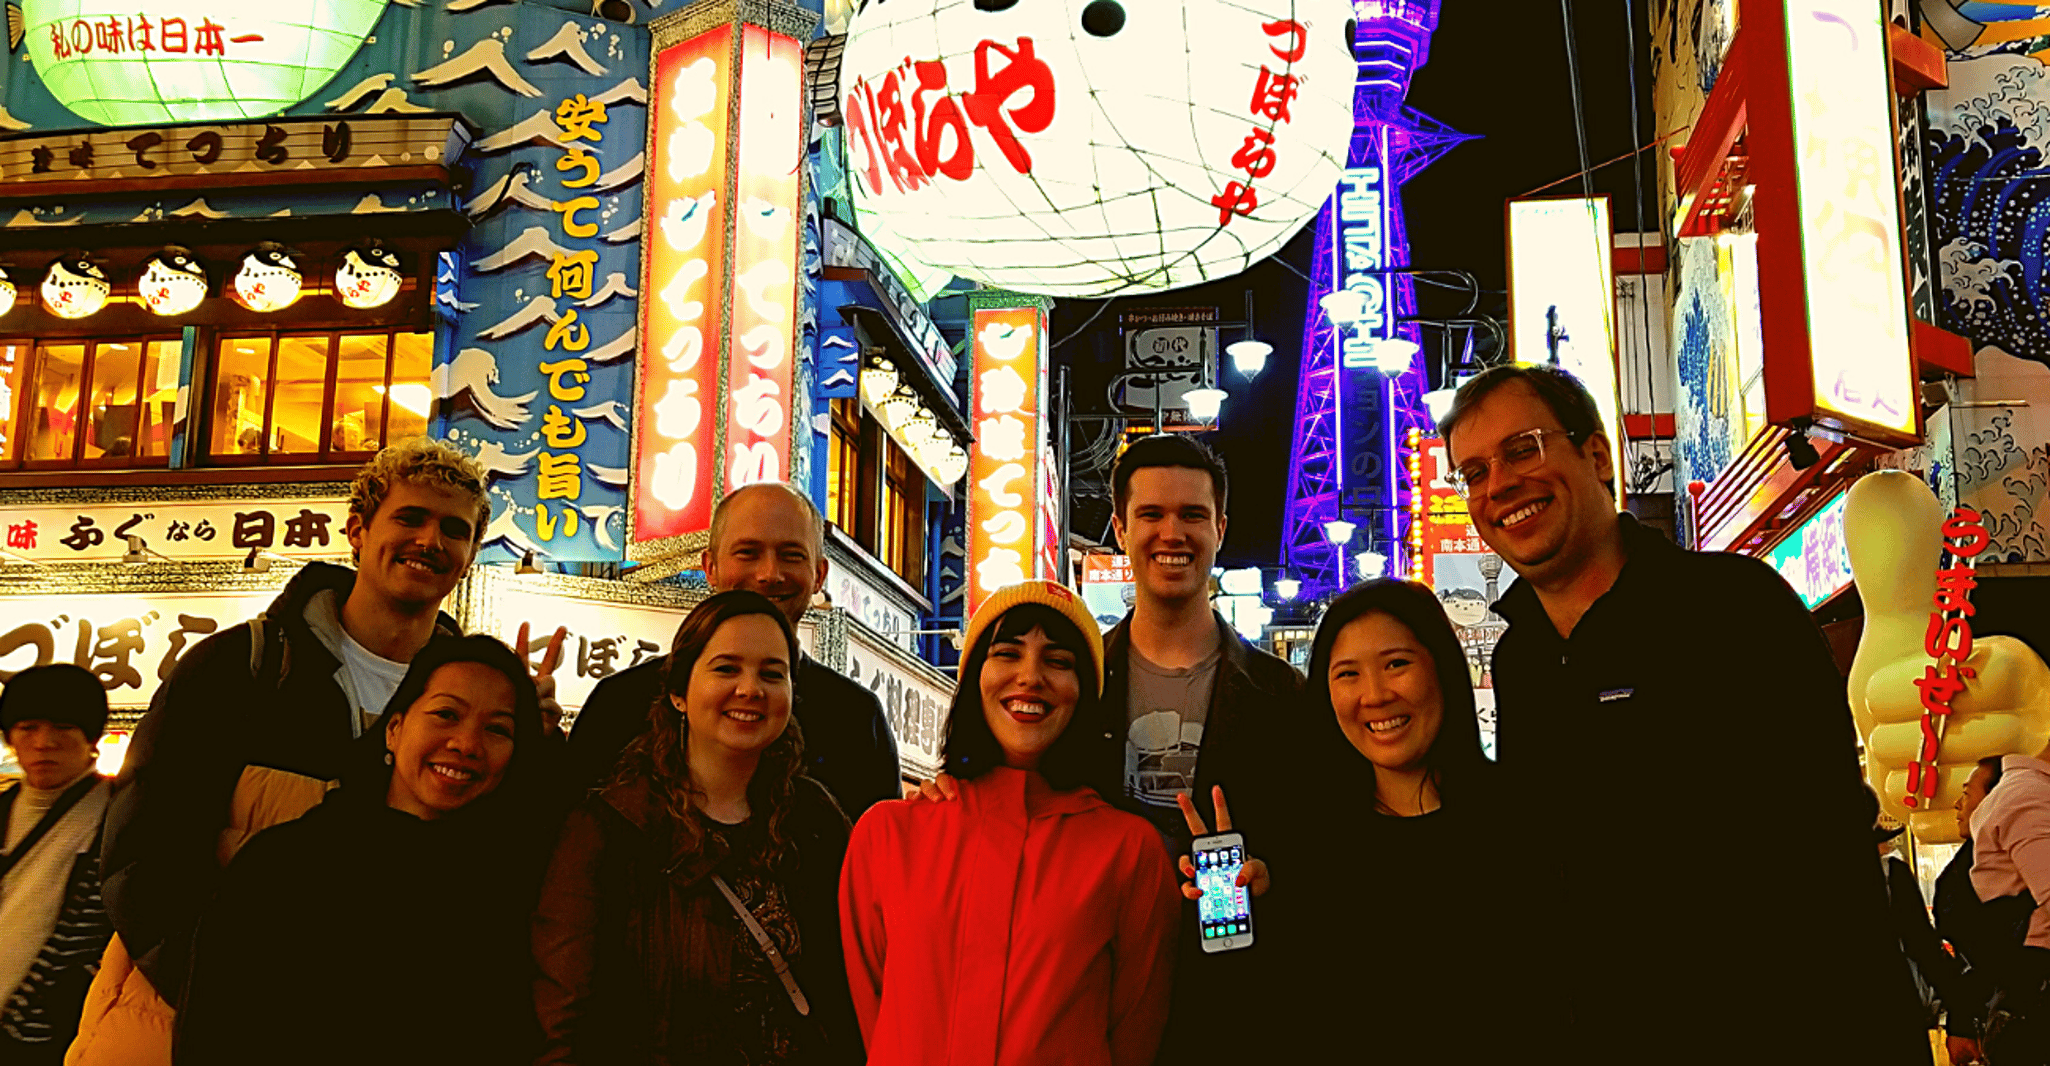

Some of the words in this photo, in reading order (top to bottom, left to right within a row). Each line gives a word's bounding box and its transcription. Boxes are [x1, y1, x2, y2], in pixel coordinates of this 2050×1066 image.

[50, 12, 264, 60] 私の味は日本一
[535, 94, 608, 541] 安うて何んでも旨い
[1340, 166, 1384, 369] HITACHI
[60, 509, 347, 551] ふぐなら日本
